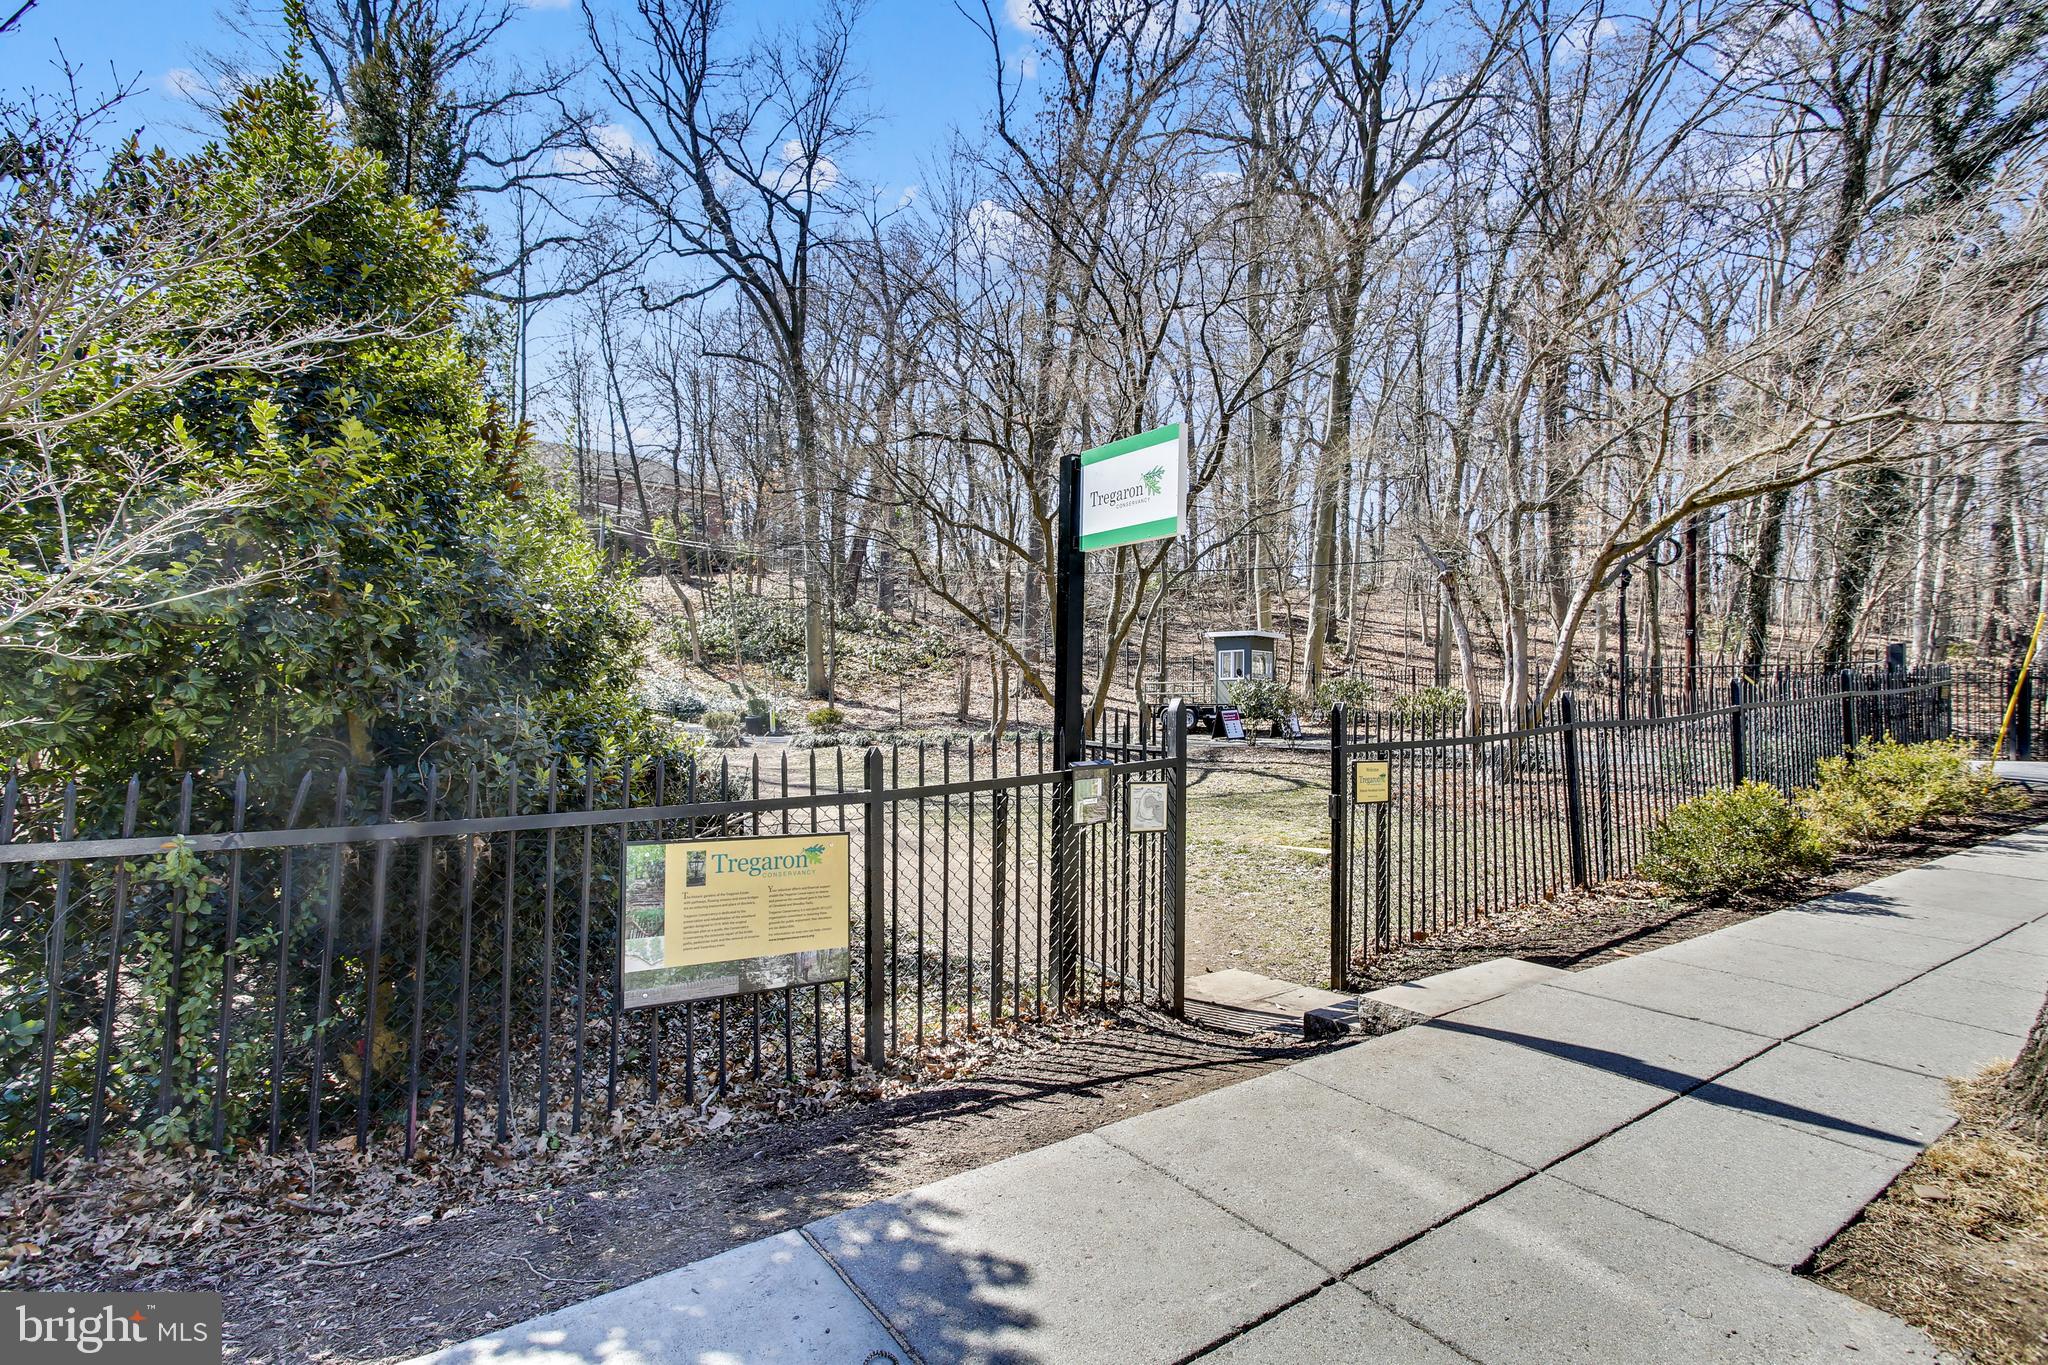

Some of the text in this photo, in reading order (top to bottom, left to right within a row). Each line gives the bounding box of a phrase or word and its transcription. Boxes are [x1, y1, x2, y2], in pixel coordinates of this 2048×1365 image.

[1090, 484, 1144, 508] Tregaron
[1115, 497, 1151, 510] CONSERVANCY
[711, 852, 809, 877] Tregaron
[762, 869, 817, 879] CONSERVANCY
